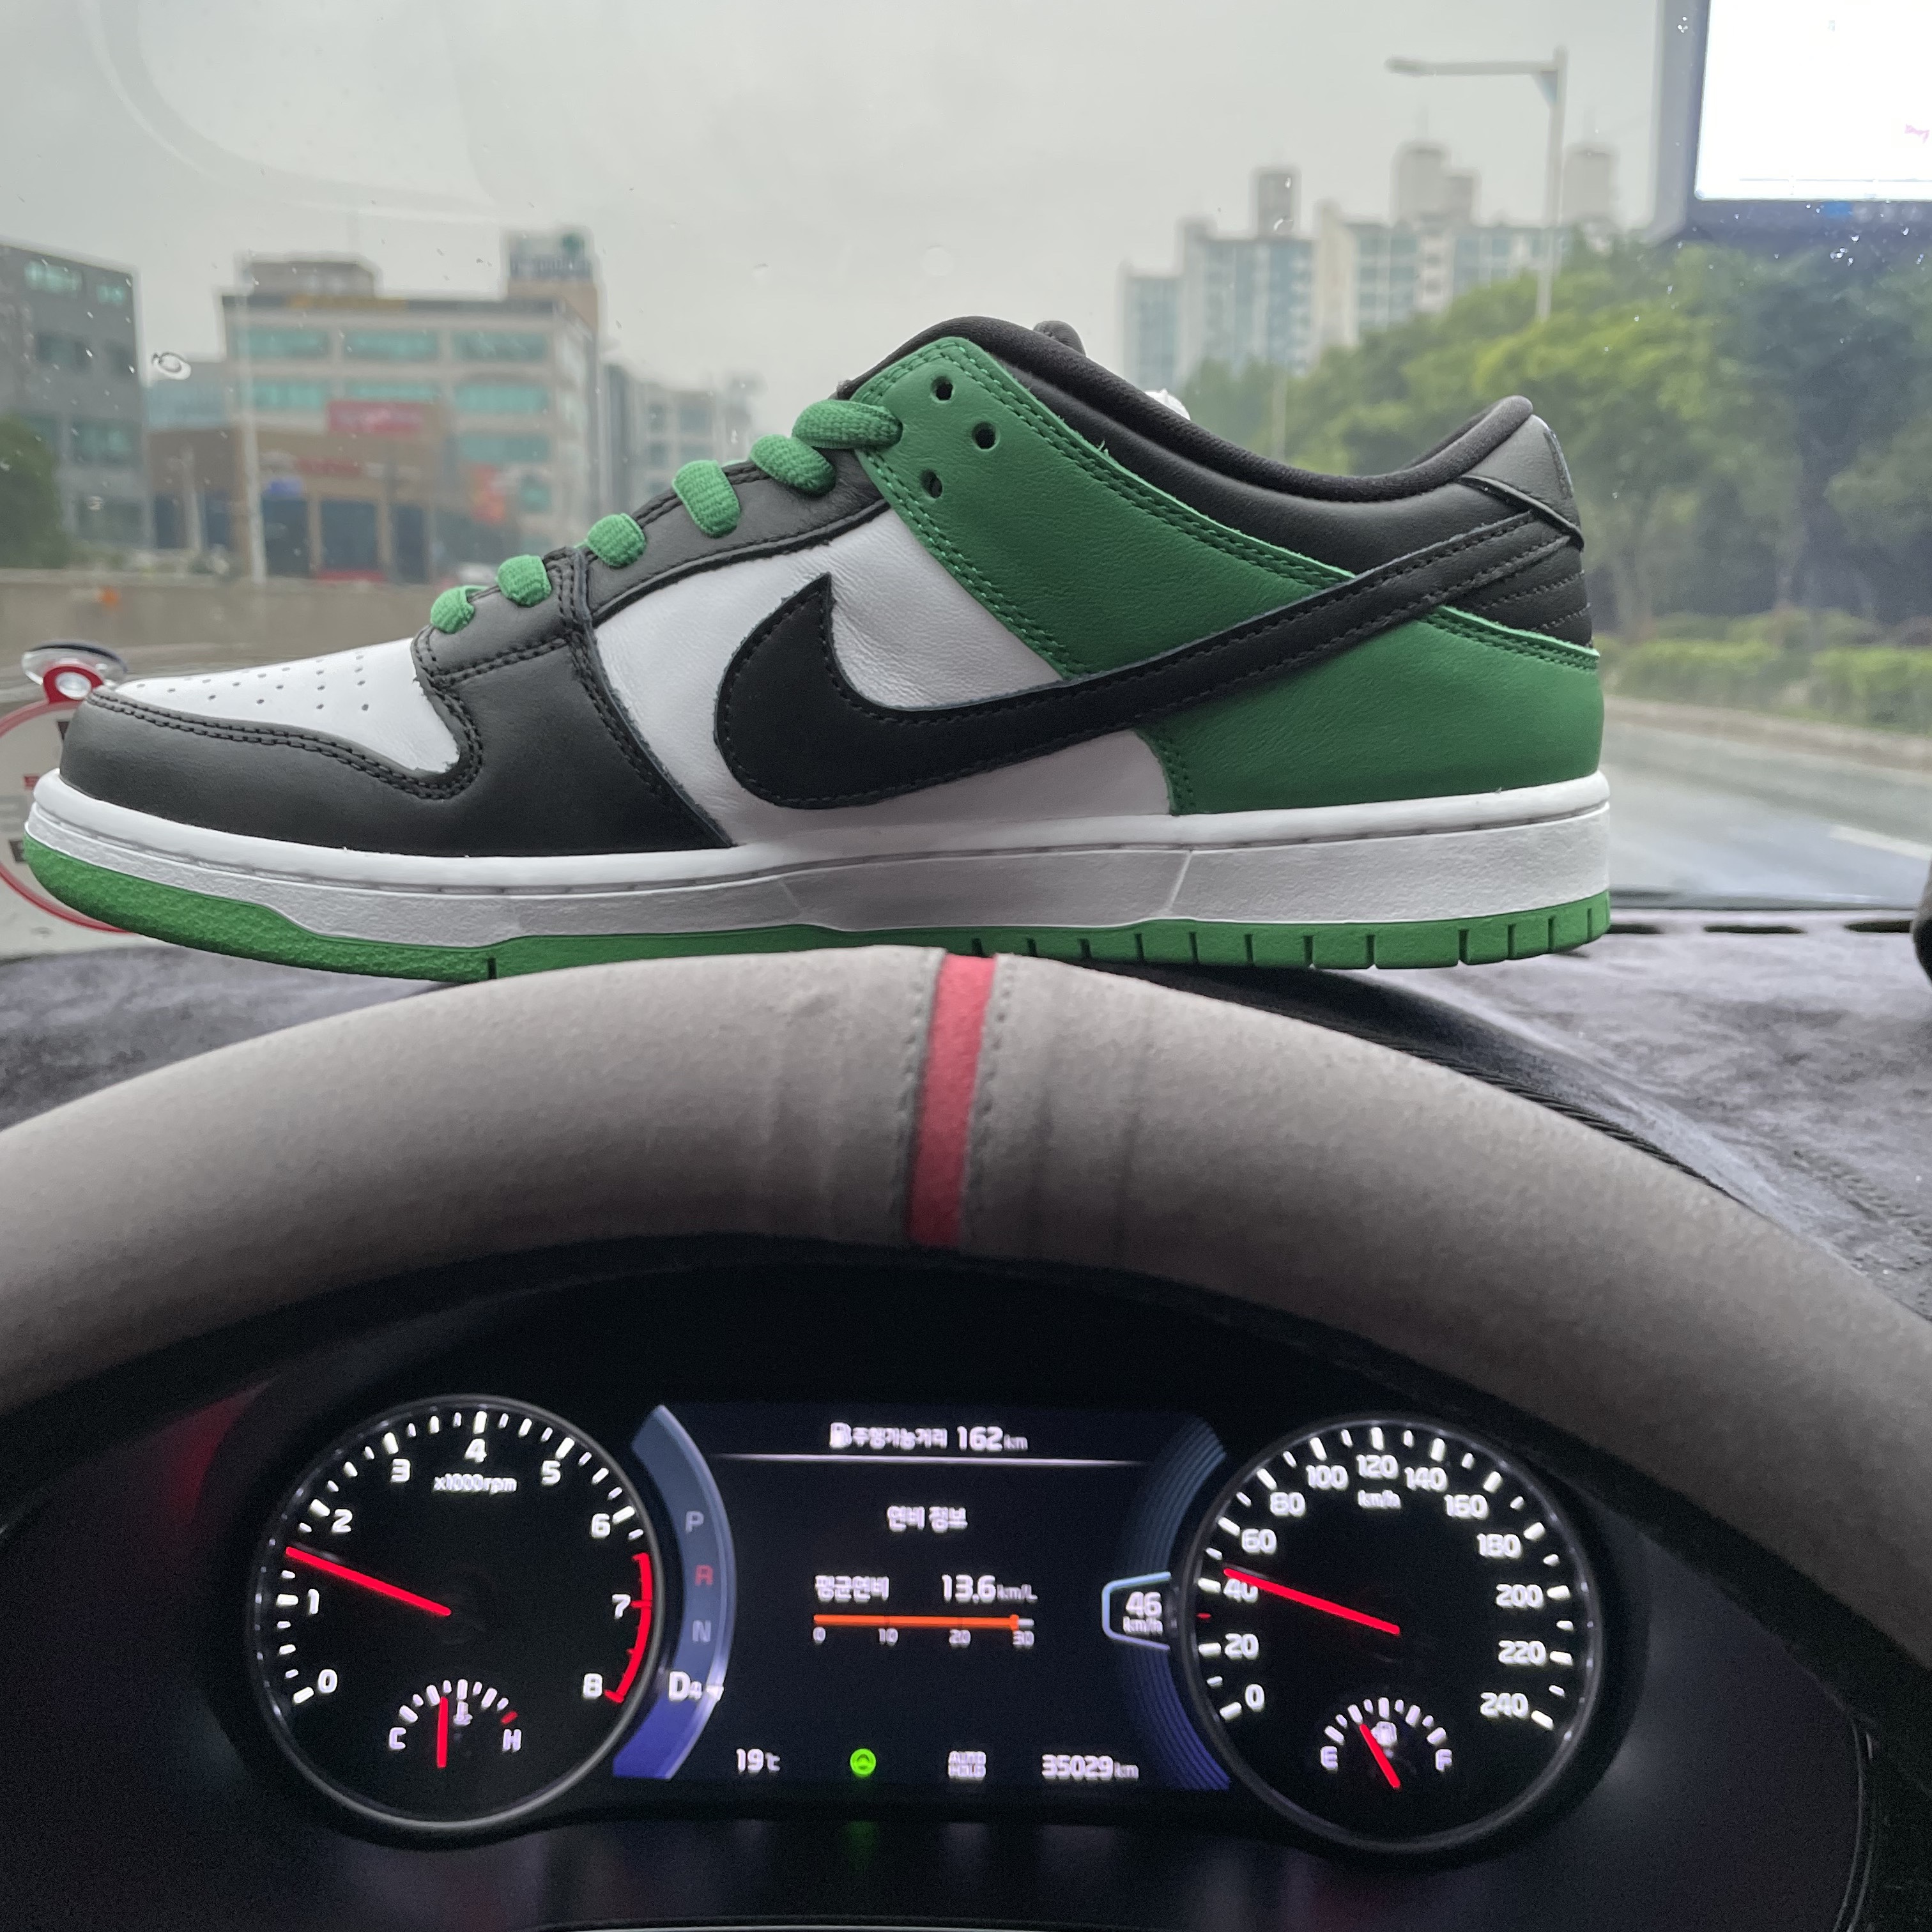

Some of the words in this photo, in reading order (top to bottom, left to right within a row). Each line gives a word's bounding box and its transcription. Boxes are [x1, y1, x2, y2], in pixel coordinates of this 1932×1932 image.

[463, 1438, 487, 1464] 4
[390, 1458, 411, 1483] 3
[540, 1460, 562, 1486] 5
[1305, 1464, 1350, 1491] 100
[1354, 1454, 1399, 1480] 120
[1403, 1466, 1448, 1493] 140
[1269, 1491, 1307, 1517] 80
[1356, 1489, 1402, 1510] km/h
[1444, 1493, 1489, 1520] 160
[331, 1508, 353, 1534] 2
[590, 1517, 613, 1538] 6
[685, 1510, 705, 1533] P
[886, 1505, 926, 1533] 연비
[1241, 1528, 1278, 1554] 60
[1476, 1532, 1522, 1560] 180
[694, 1564, 714, 1586] R
[307, 1588, 320, 1615] 1
[814, 1574, 891, 1603] 평균연비
[1223, 1577, 1259, 1604] 40
[1496, 1584, 1545, 1609] 200
[611, 1593, 631, 1620] 7
[1124, 1591, 1163, 1619] 46
[691, 1620, 712, 1643] N
[812, 1627, 827, 1644] 0
[878, 1628, 899, 1646] 10
[948, 1629, 972, 1647] 20
[1012, 1630, 1036, 1648] 30
[1122, 1616, 1164, 1636] km/h
[1223, 1632, 1260, 1660] 20
[1498, 1640, 1547, 1667] 220
[317, 1669, 339, 1694] 0
[582, 1672, 604, 1699] 8
[1244, 1683, 1266, 1711] 0
[1480, 1692, 1529, 1719] 240
[388, 1726, 407, 1751] C
[502, 1728, 523, 1753] H
[1320, 1745, 1338, 1770] E
[1434, 1748, 1453, 1772] F
